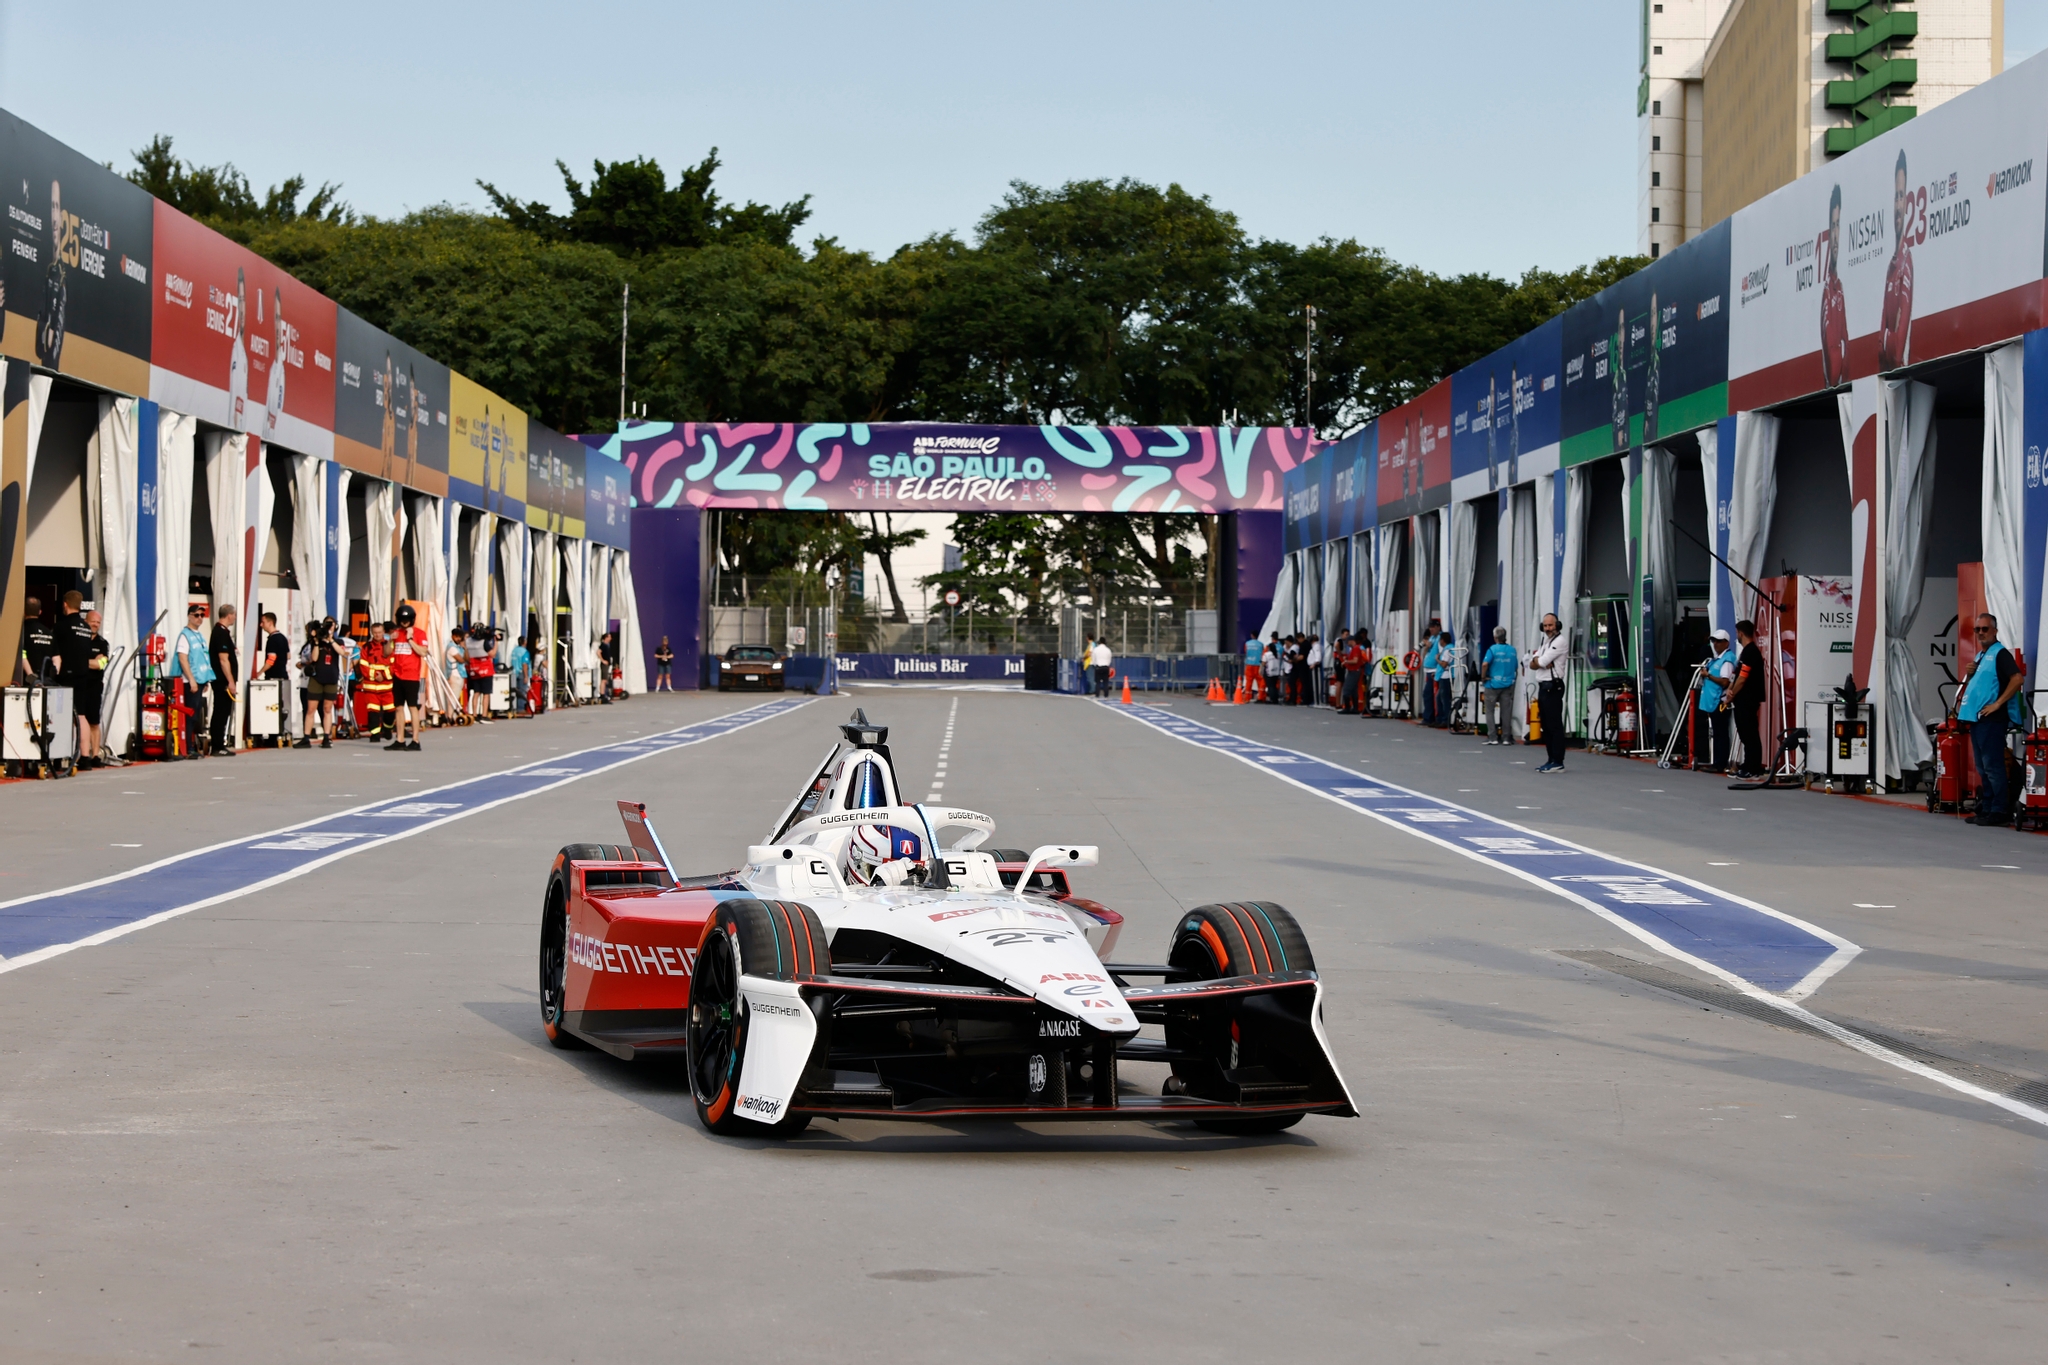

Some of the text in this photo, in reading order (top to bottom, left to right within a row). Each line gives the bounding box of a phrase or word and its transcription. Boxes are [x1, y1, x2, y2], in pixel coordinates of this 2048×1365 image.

[1994, 159, 2033, 196] Hankook
[1930, 179, 1947, 204] Oliver
[1904, 186, 1927, 248] 23
[1929, 199, 1971, 239] ROWLAND
[60, 209, 79, 268] 25
[1848, 209, 1884, 253] NISSAN
[12, 239, 38, 262] PENSKE
[80, 246, 105, 279] VERGNE
[1815, 229, 1830, 283] 17
[1796, 264, 1813, 293] NATO
[206, 307, 225, 334] DENNIS
[225, 292, 239, 339] 27
[251, 334, 269, 358] ANDRETTI
[280, 319, 291, 364] 51
[913, 437, 934, 447] ABB
[934, 436, 983, 449] FORMULA
[868, 452, 1053, 480] SÃO PAULO.
[896, 475, 1016, 502] ELECTRIC.
[1820, 612, 1852, 623] NISS
[1931, 643, 1955, 656] NI
[894, 657, 968, 674] Julius Bär
[1004, 659, 1025, 675] Jul
[820, 812, 889, 825] GUGGENHEIM
[948, 812, 991, 824] GUGGENHEIM
[945, 861, 967, 875] G
[986, 931, 1068, 947] 27
[1039, 973, 1106, 984] ABB
[752, 1003, 801, 1018] GUGGENHEIM
[1046, 1020, 1082, 1037] NAGASE
[742, 1096, 781, 1116] Hankook
